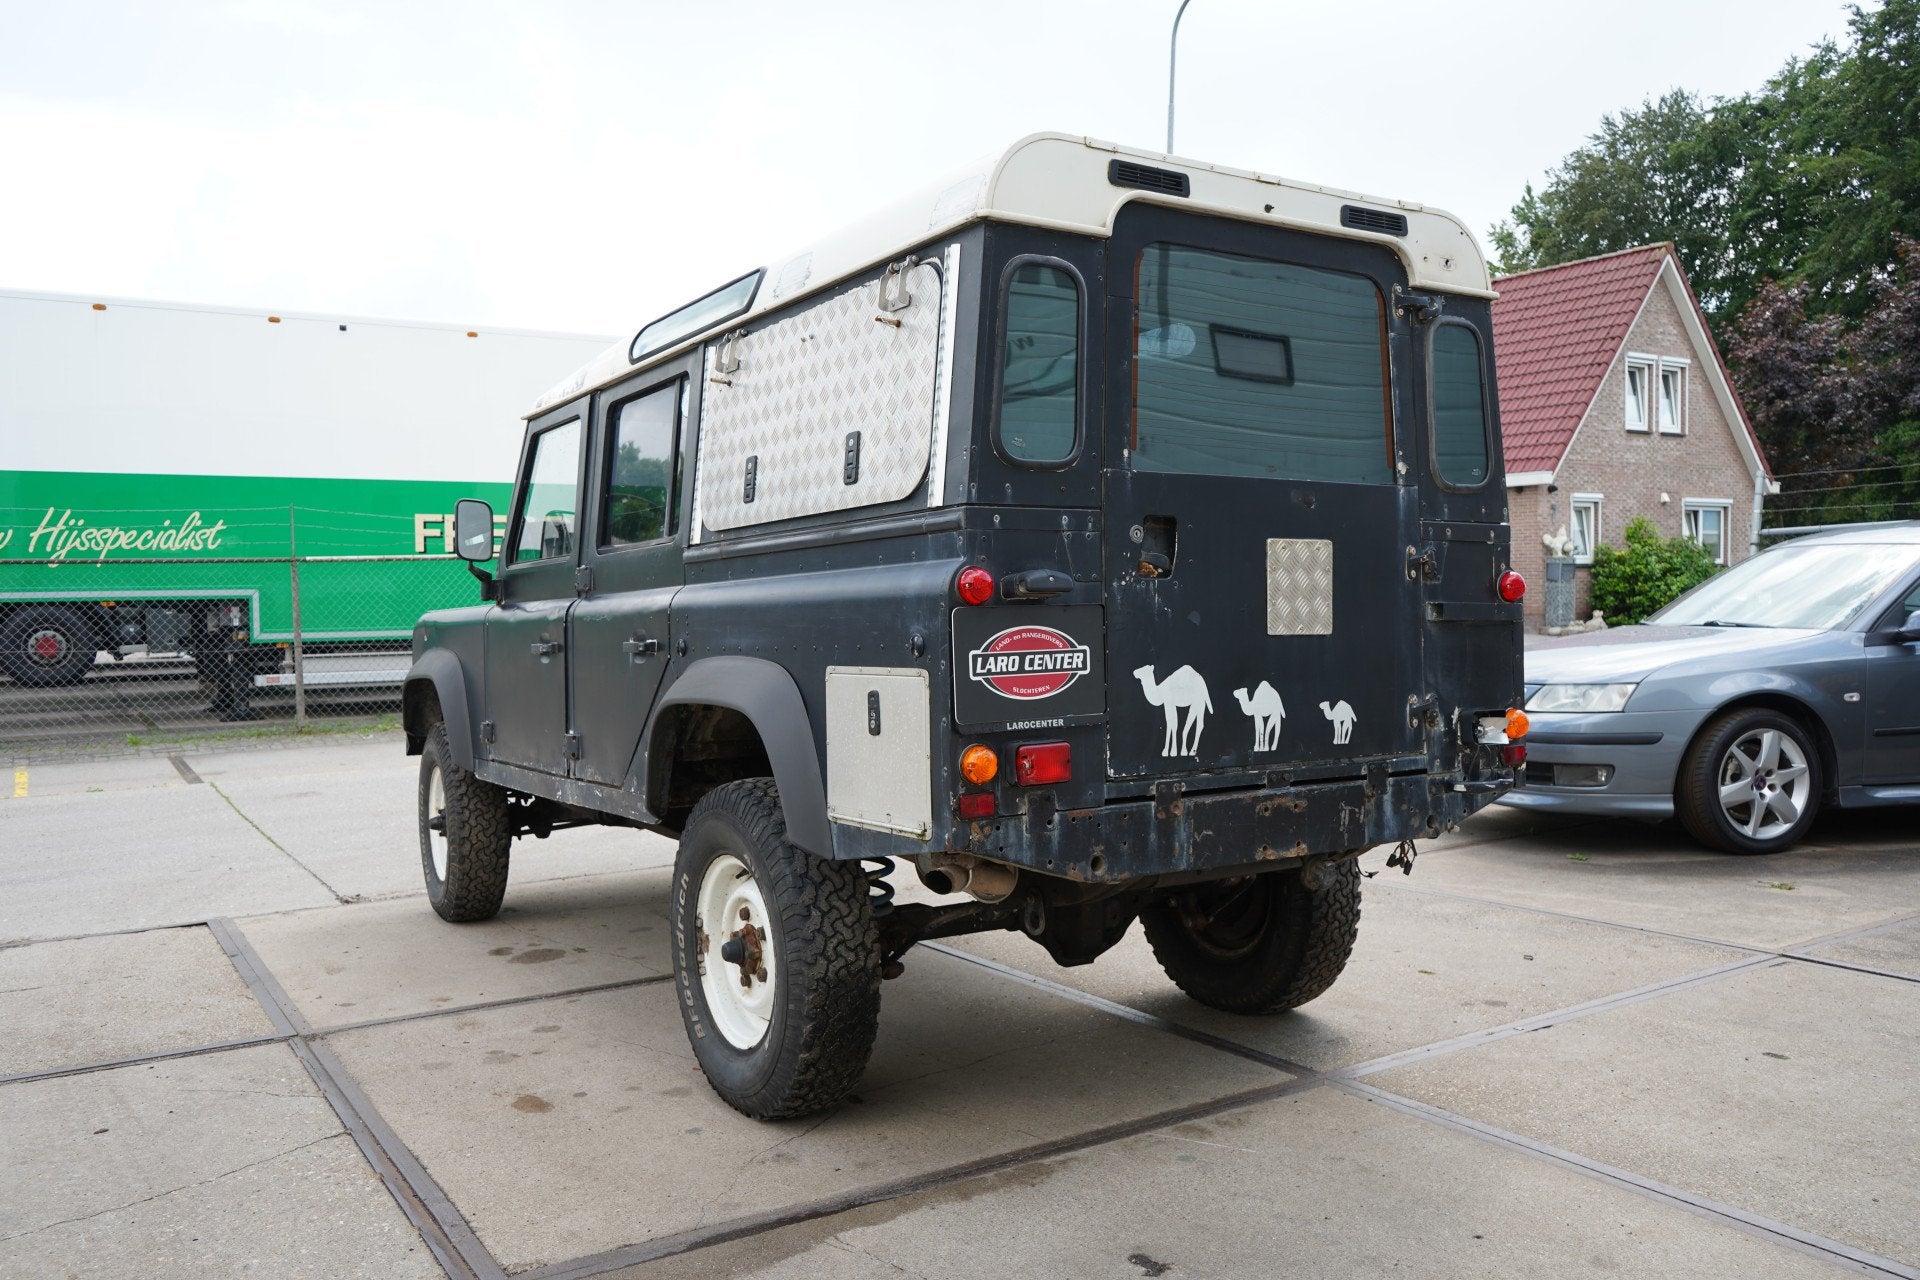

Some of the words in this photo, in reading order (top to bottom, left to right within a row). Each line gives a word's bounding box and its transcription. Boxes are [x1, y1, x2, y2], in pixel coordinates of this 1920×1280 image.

[28, 507, 227, 568] Hijsspecialist
[976, 655, 1020, 674] LARO
[1024, 652, 1084, 671] CENTER
[1006, 718, 1064, 731] LAROCENTER
[676, 872, 706, 1039] BFGoodrich
